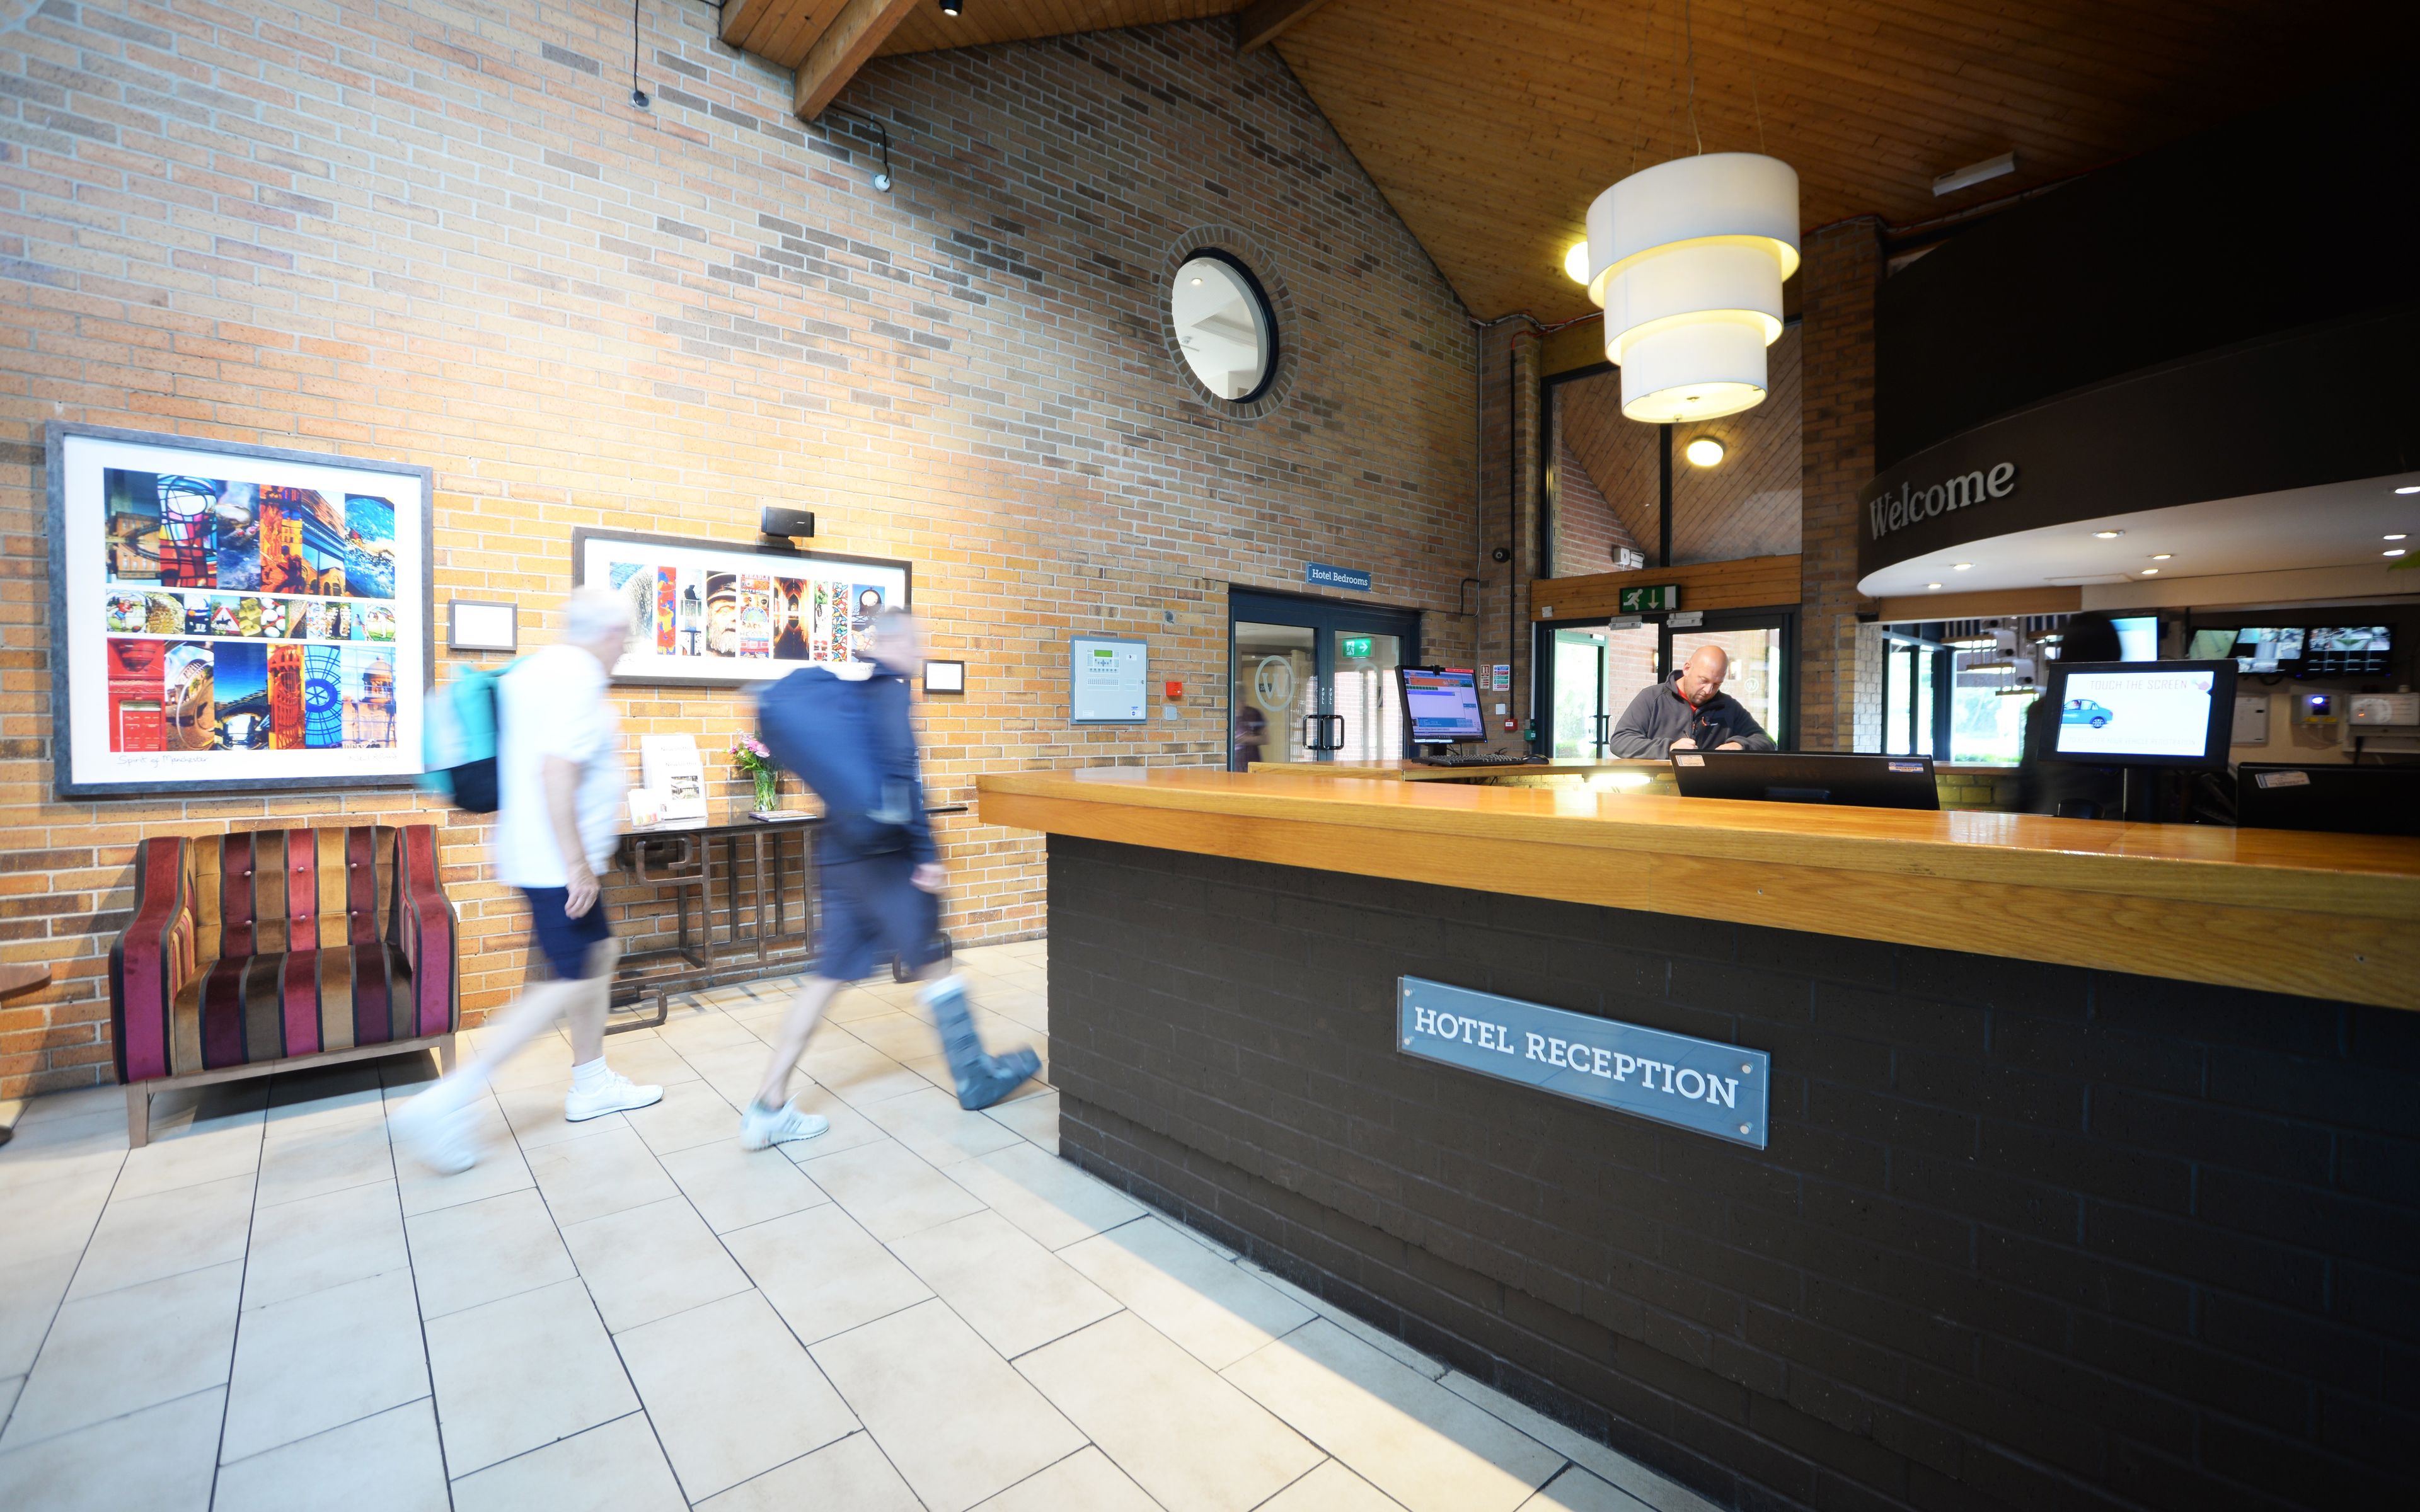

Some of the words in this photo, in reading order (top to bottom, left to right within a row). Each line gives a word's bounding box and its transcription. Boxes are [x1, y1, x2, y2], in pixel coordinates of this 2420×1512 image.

[1869, 462, 2015, 541] Welcome
[1312, 568, 1332, 580] Hotel
[1333, 572, 1368, 586] Bedrooms
[2090, 680, 2122, 690] TOUCH
[2126, 680, 2143, 690] THE
[2148, 679, 2187, 690] SCREEN
[117, 755, 146, 767] Spirit
[151, 757, 159, 769] of
[162, 755, 209, 765] Manchester
[1415, 1006, 1514, 1055] HOTEL
[1526, 1032, 1739, 1109] RECEPTION
